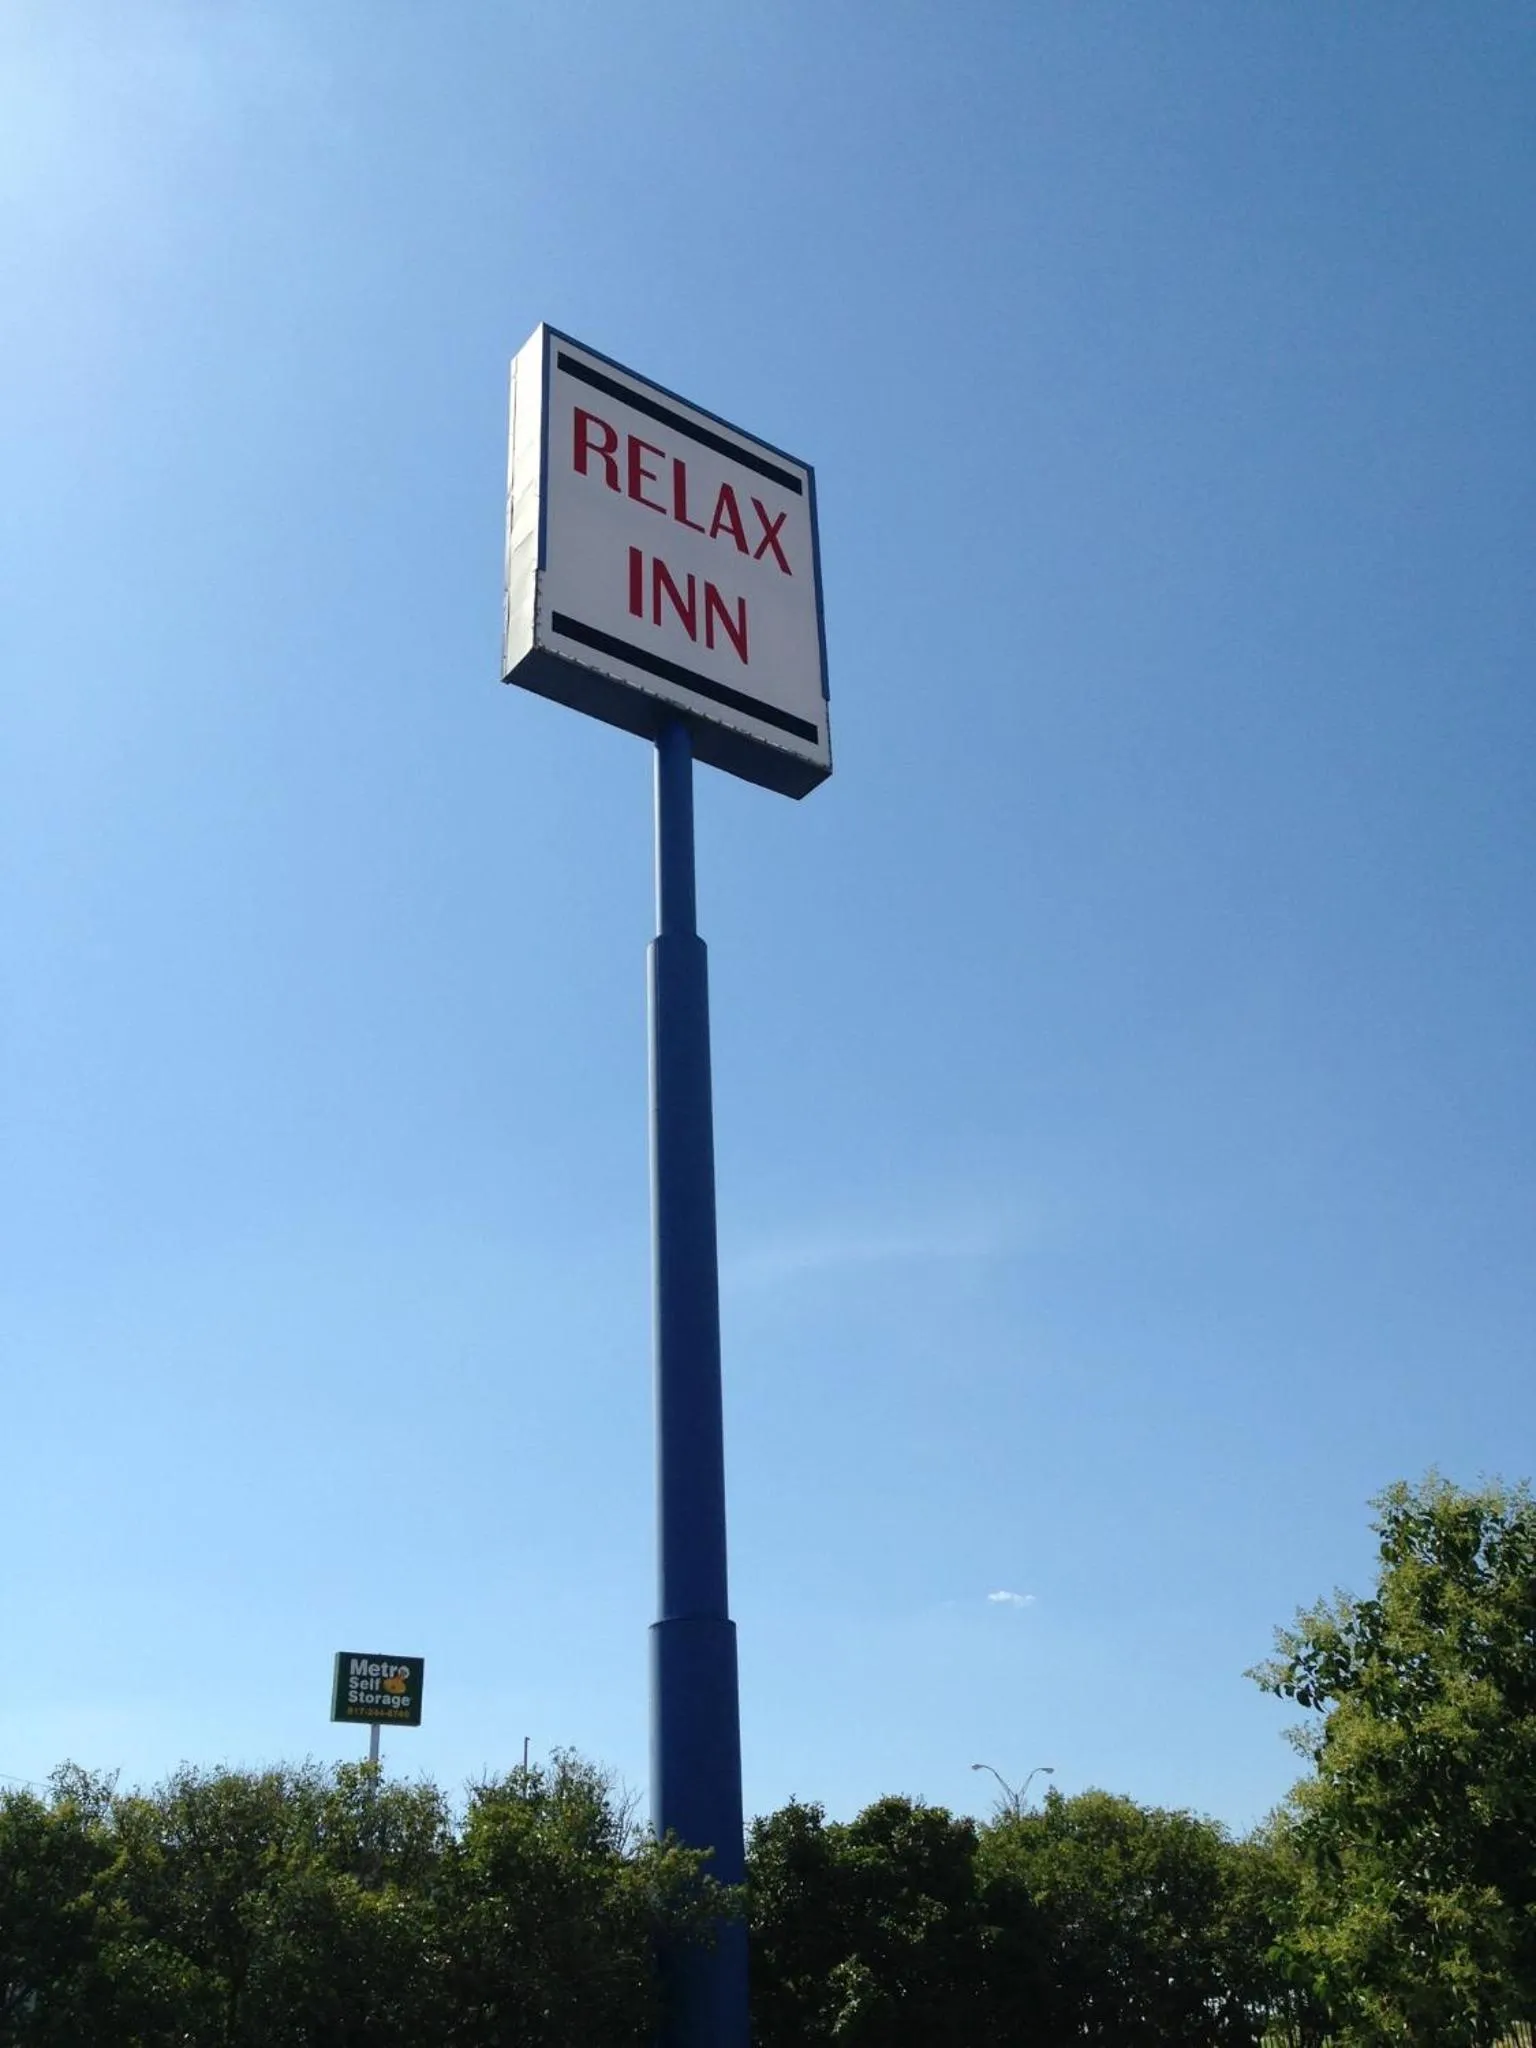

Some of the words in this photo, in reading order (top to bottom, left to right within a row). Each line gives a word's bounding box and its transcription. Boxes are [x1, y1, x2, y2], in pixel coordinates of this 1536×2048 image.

[573, 406, 793, 576] RELAX
[629, 546, 748, 665] INN
[350, 1658, 410, 1679] Metro
[349, 1676, 381, 1691] Self
[348, 1690, 411, 1708] Storage
